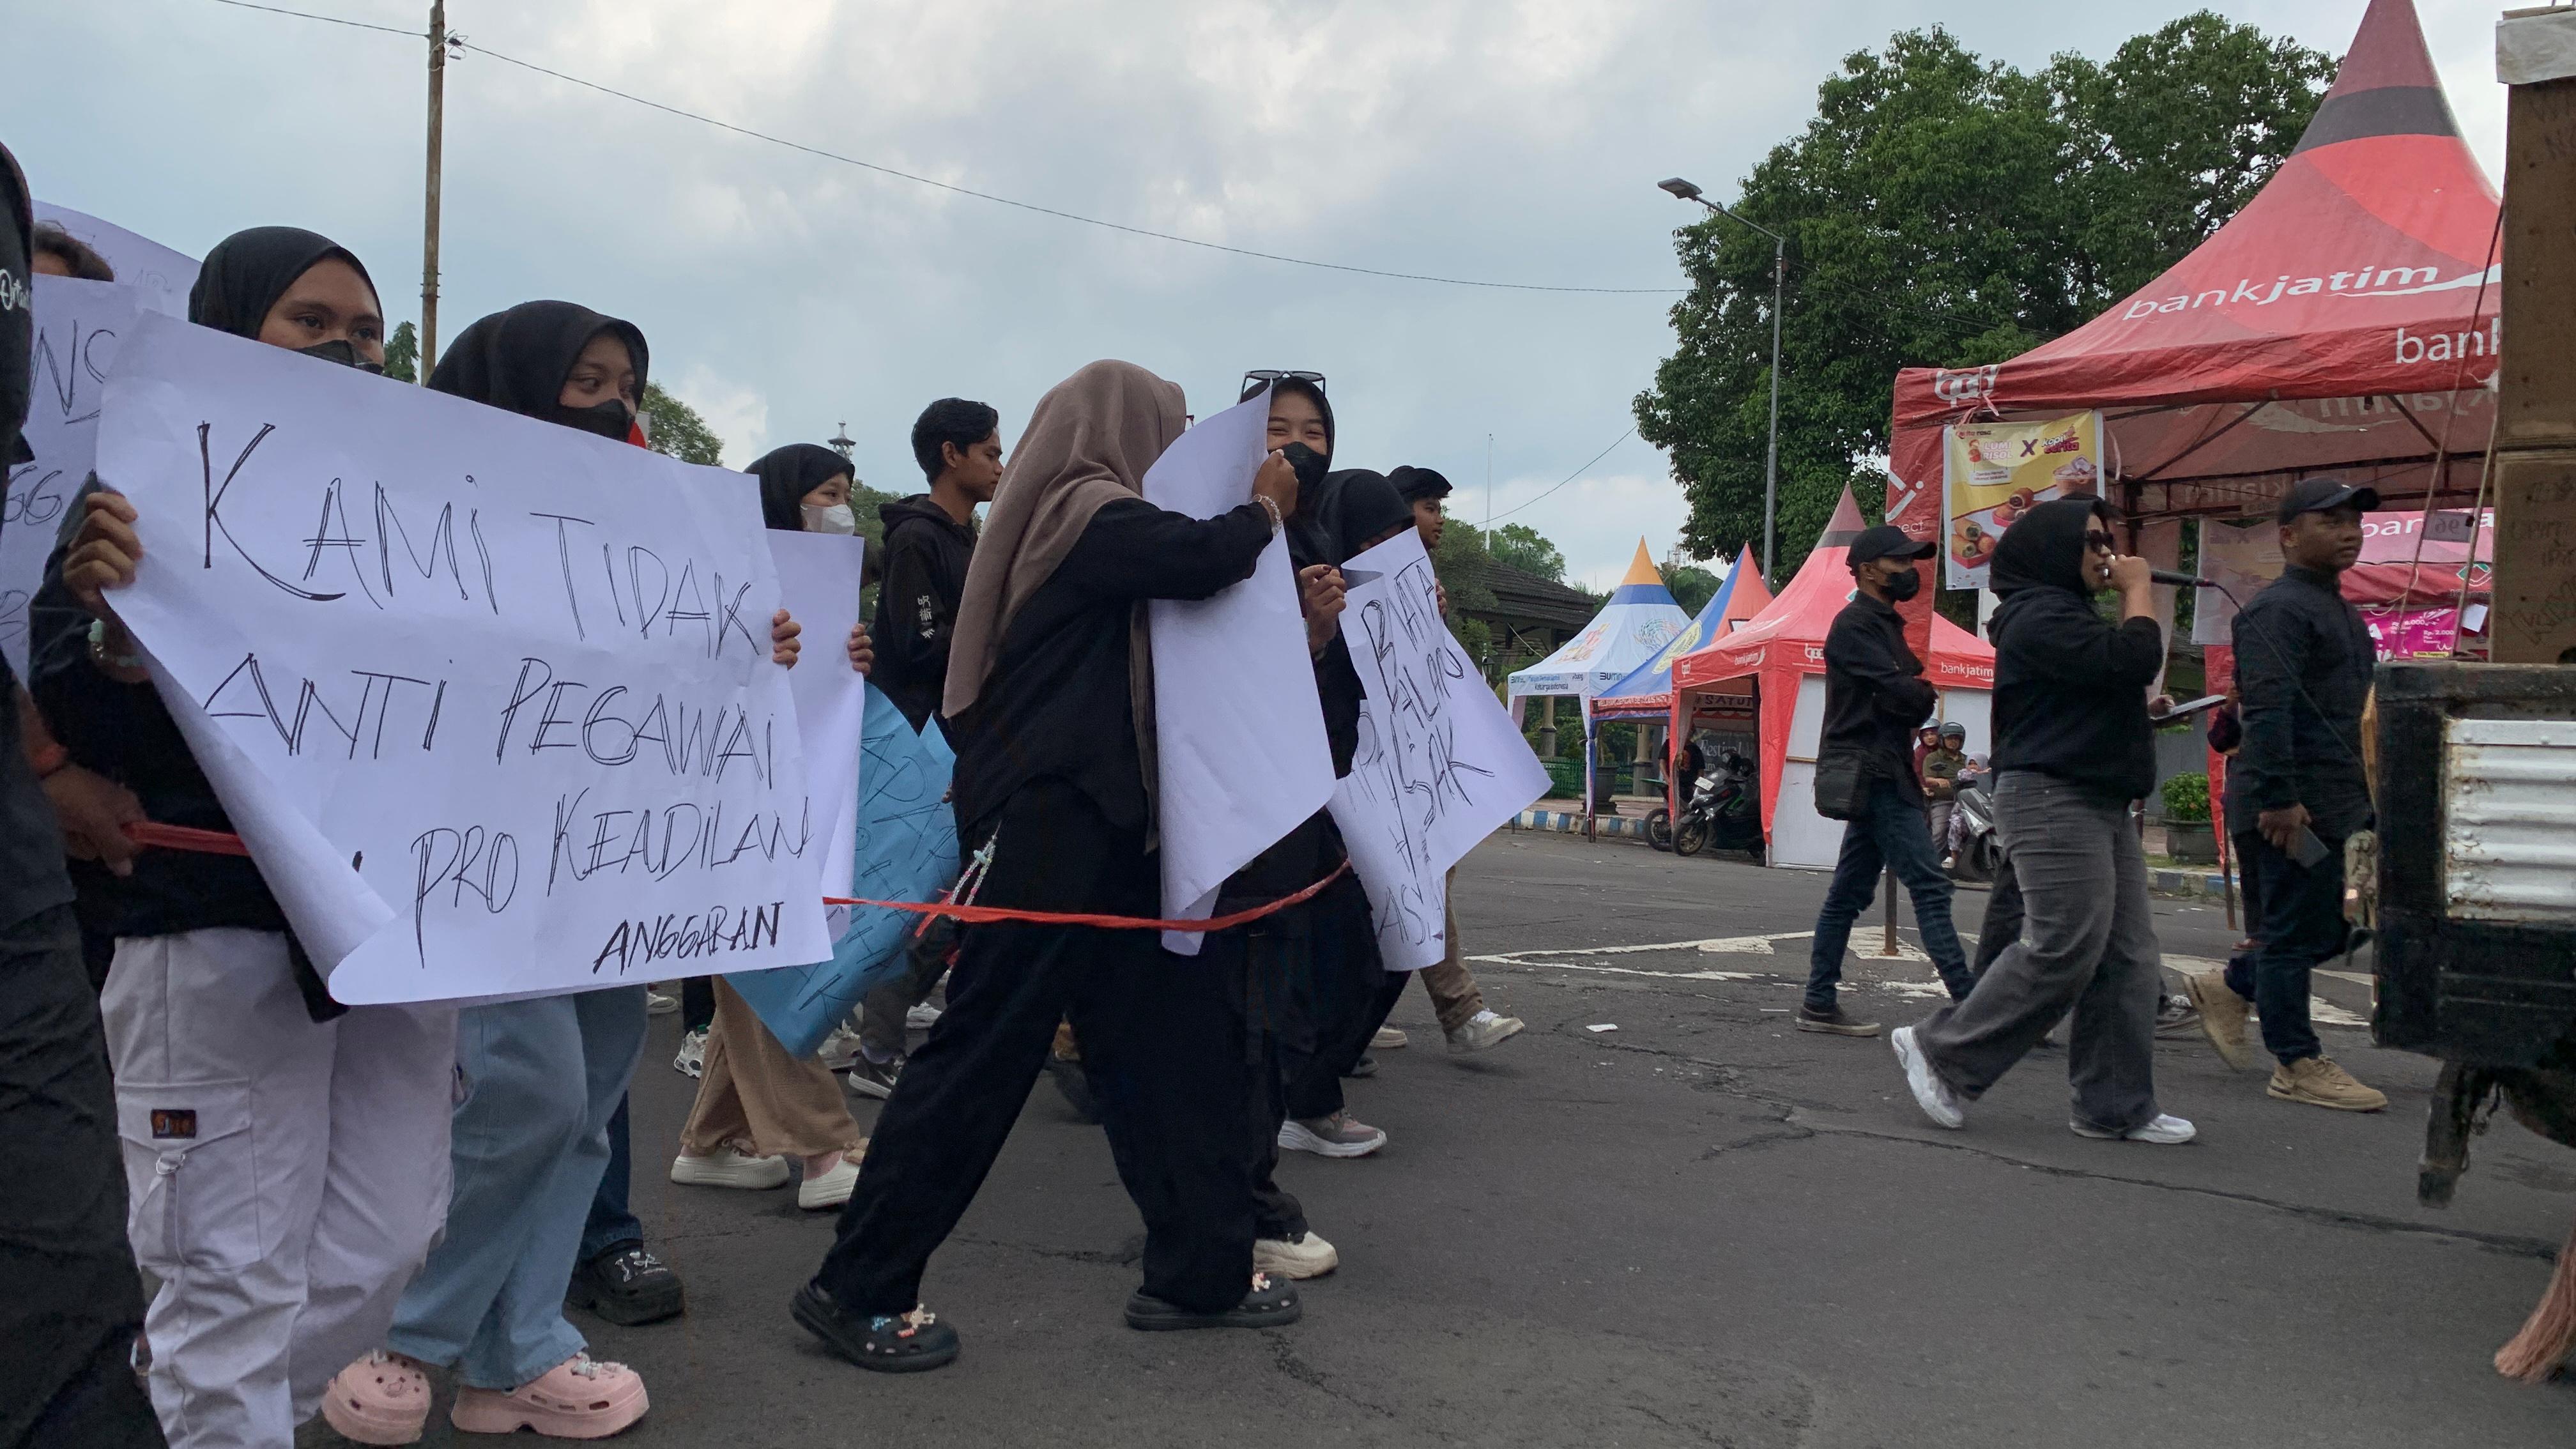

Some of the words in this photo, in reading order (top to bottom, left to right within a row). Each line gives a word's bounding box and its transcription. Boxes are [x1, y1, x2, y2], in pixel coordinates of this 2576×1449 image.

[2122, 266, 2438, 321] bankjatim
[530, 512, 761, 659] TIDAK
[1941, 661, 1994, 678] bankjatim
[411, 826, 519, 969] PRO
[593, 901, 785, 974] ANGGARAN
